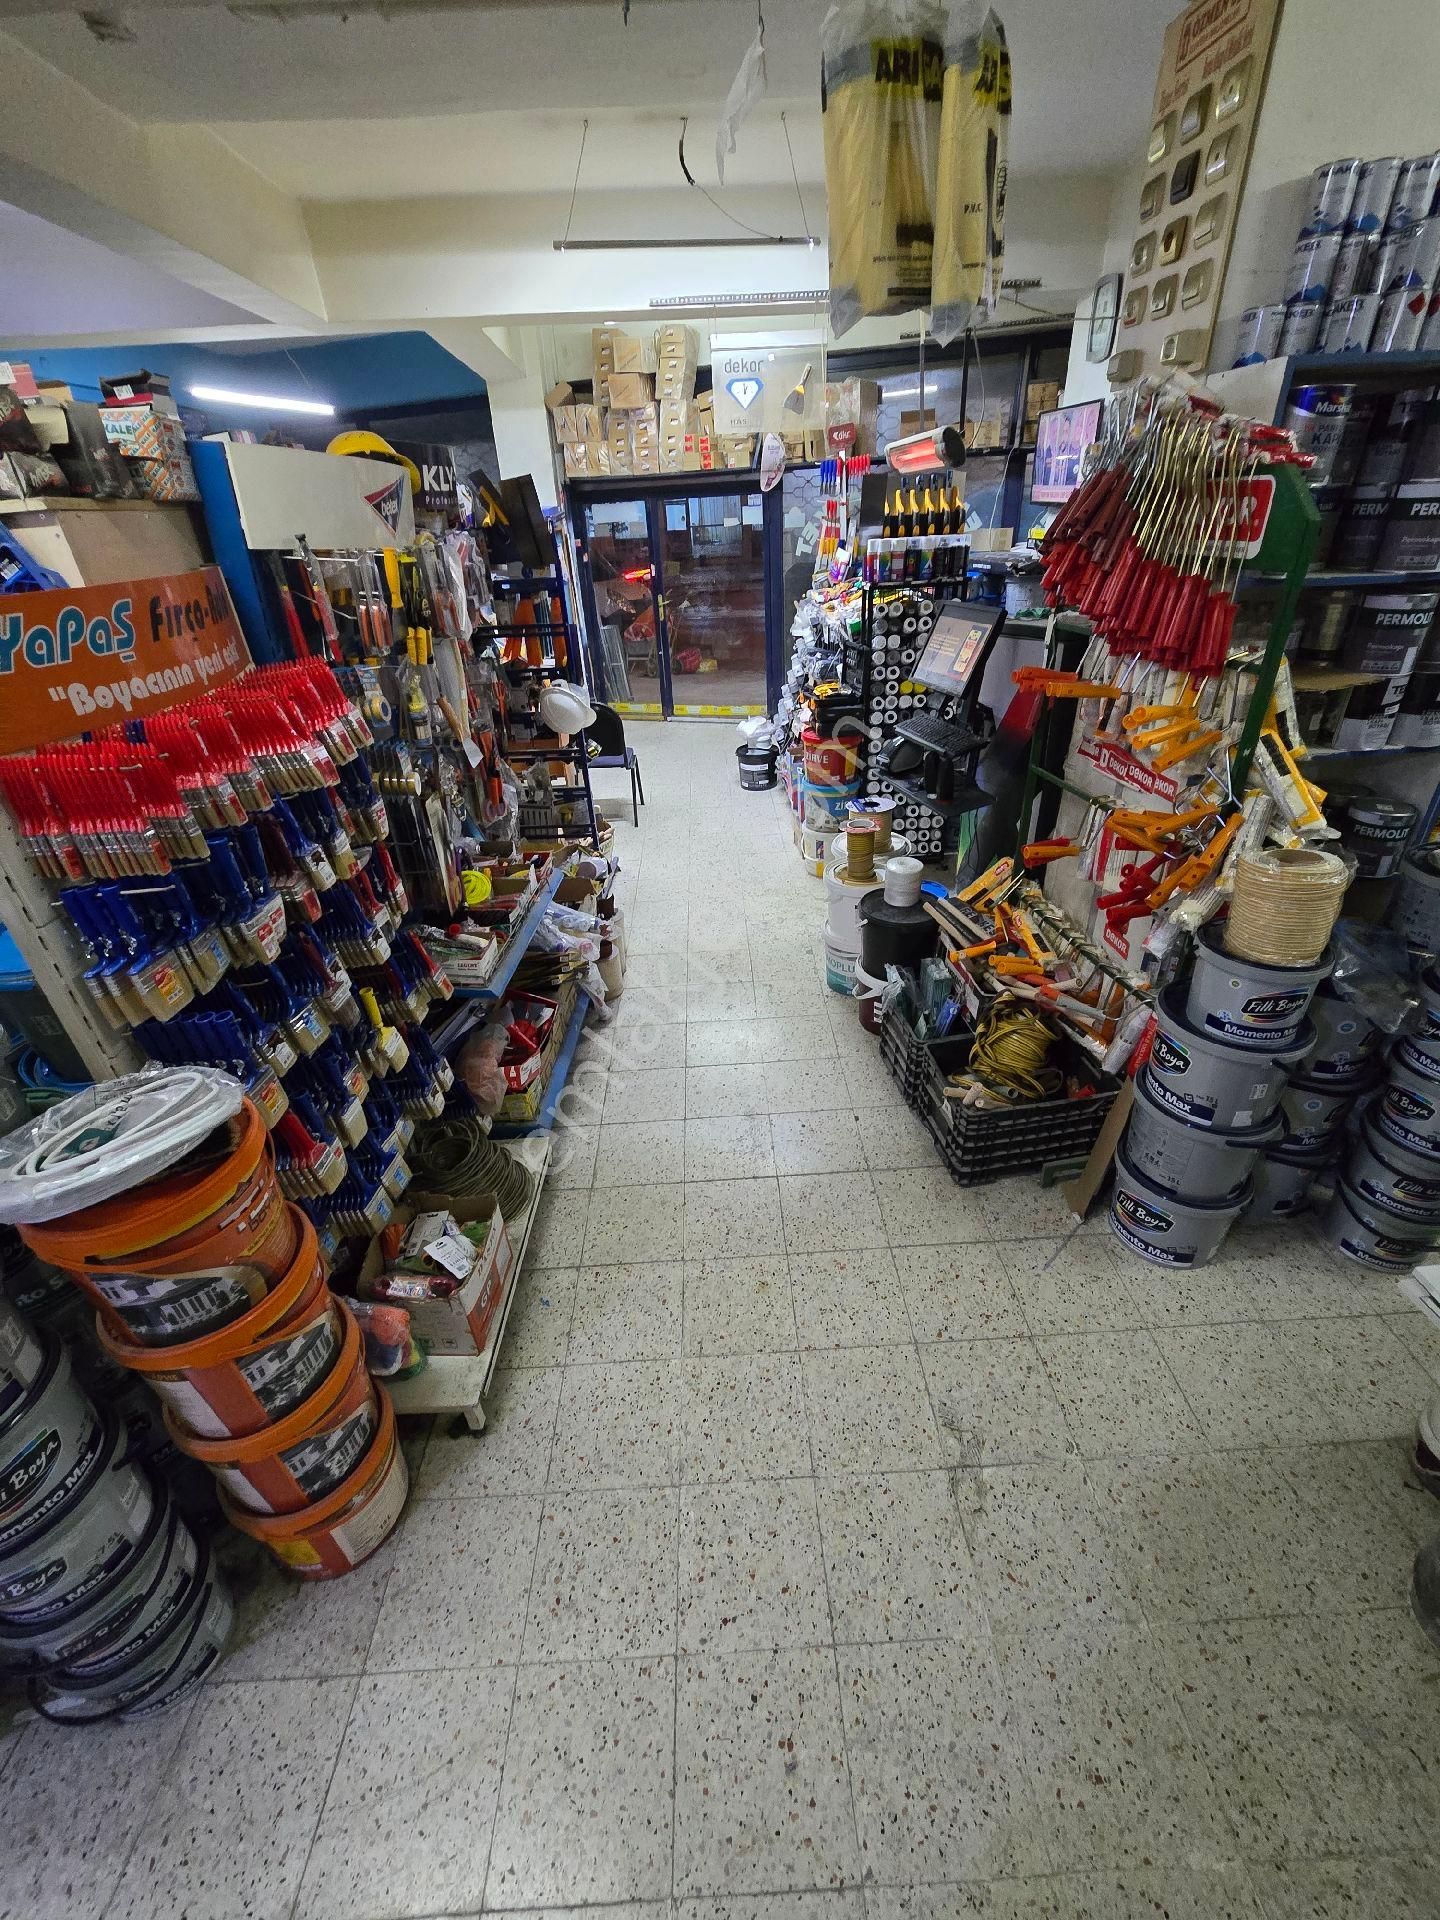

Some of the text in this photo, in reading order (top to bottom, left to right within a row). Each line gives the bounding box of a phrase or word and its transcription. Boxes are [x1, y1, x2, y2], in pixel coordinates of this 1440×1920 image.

[725, 357, 764, 374] dekor
[1410, 502, 1440, 516] PER
[1247, 1001, 1275, 1013] Filli
[1224, 1023, 1282, 1040] Momento
[1160, 1044, 1186, 1070] Boya
[1165, 1091, 1192, 1113] Max
[1400, 1095, 1430, 1117] Boya
[1406, 1131, 1434, 1150] Max
[1136, 1207, 1169, 1229] Boya
[1147, 1244, 1175, 1262] Max
[9, 1440, 58, 1490] Boya
[64, 1450, 94, 1489] Max
[7, 1564, 63, 1597] Boya
[65, 1569, 108, 1602] Max
[143, 1602, 177, 1637] Max
